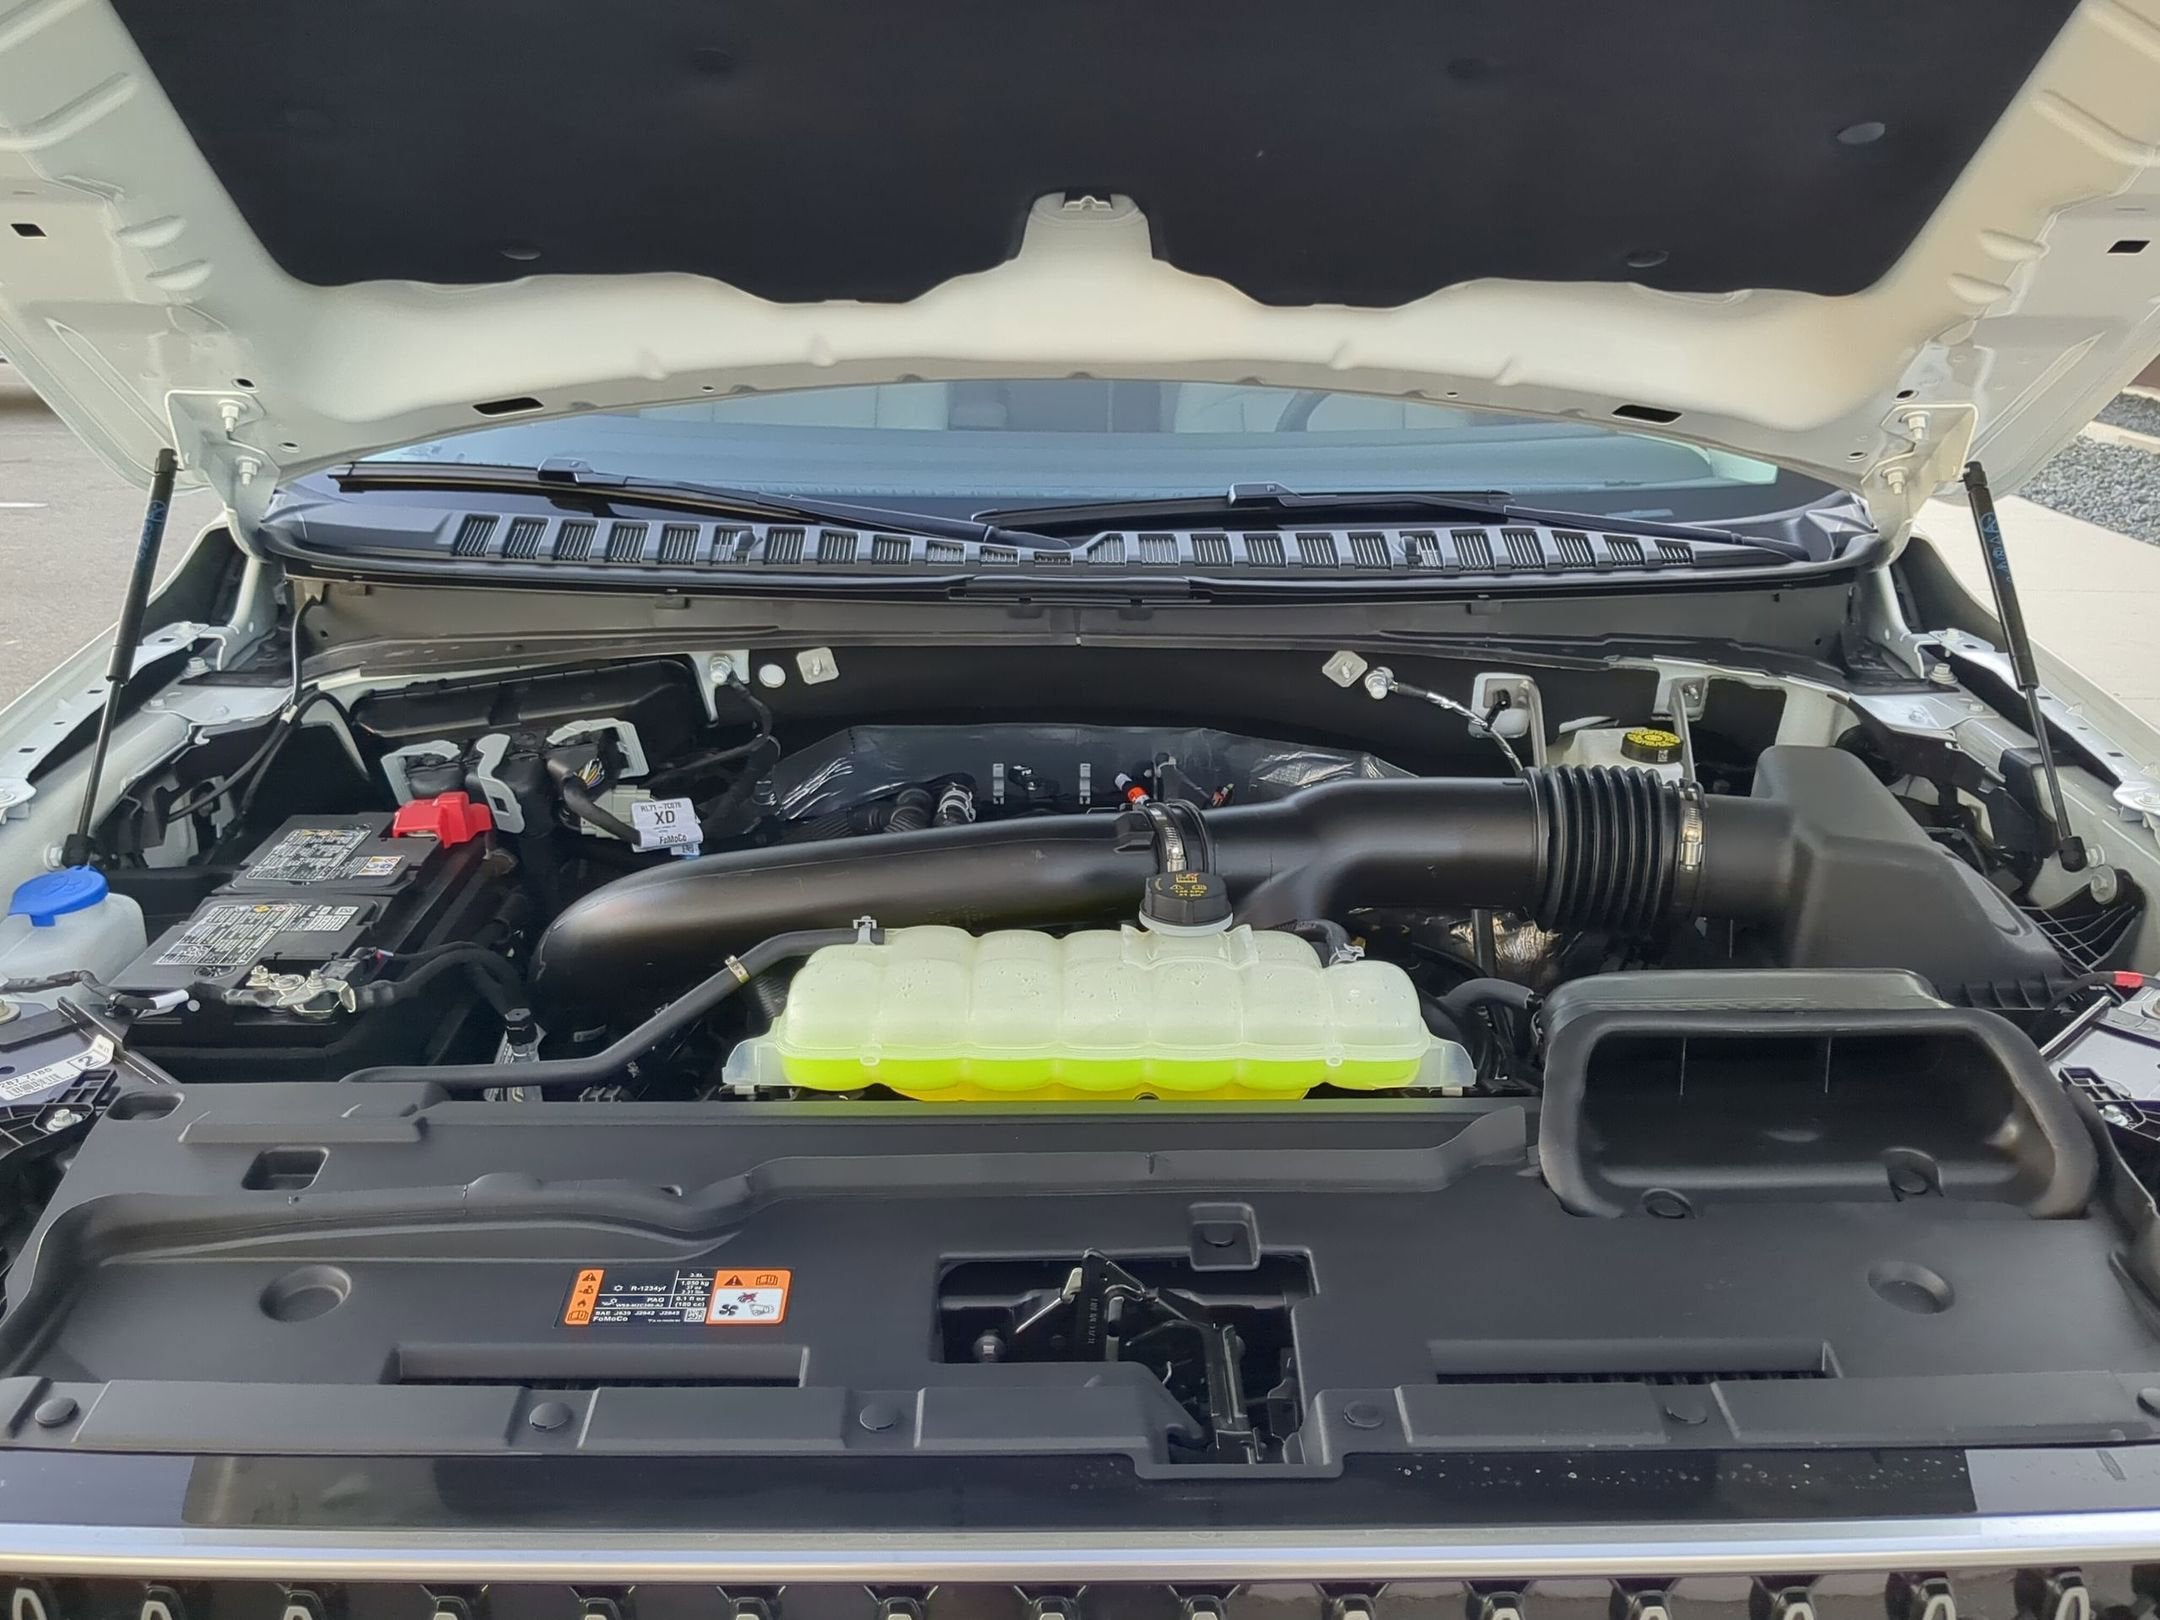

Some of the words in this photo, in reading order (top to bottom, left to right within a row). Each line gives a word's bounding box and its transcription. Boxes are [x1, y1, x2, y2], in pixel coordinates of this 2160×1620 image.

[655, 811, 675, 824] XD
[659, 834, 686, 844] FoMoCo
[78, 1056, 98, 1067] 2
